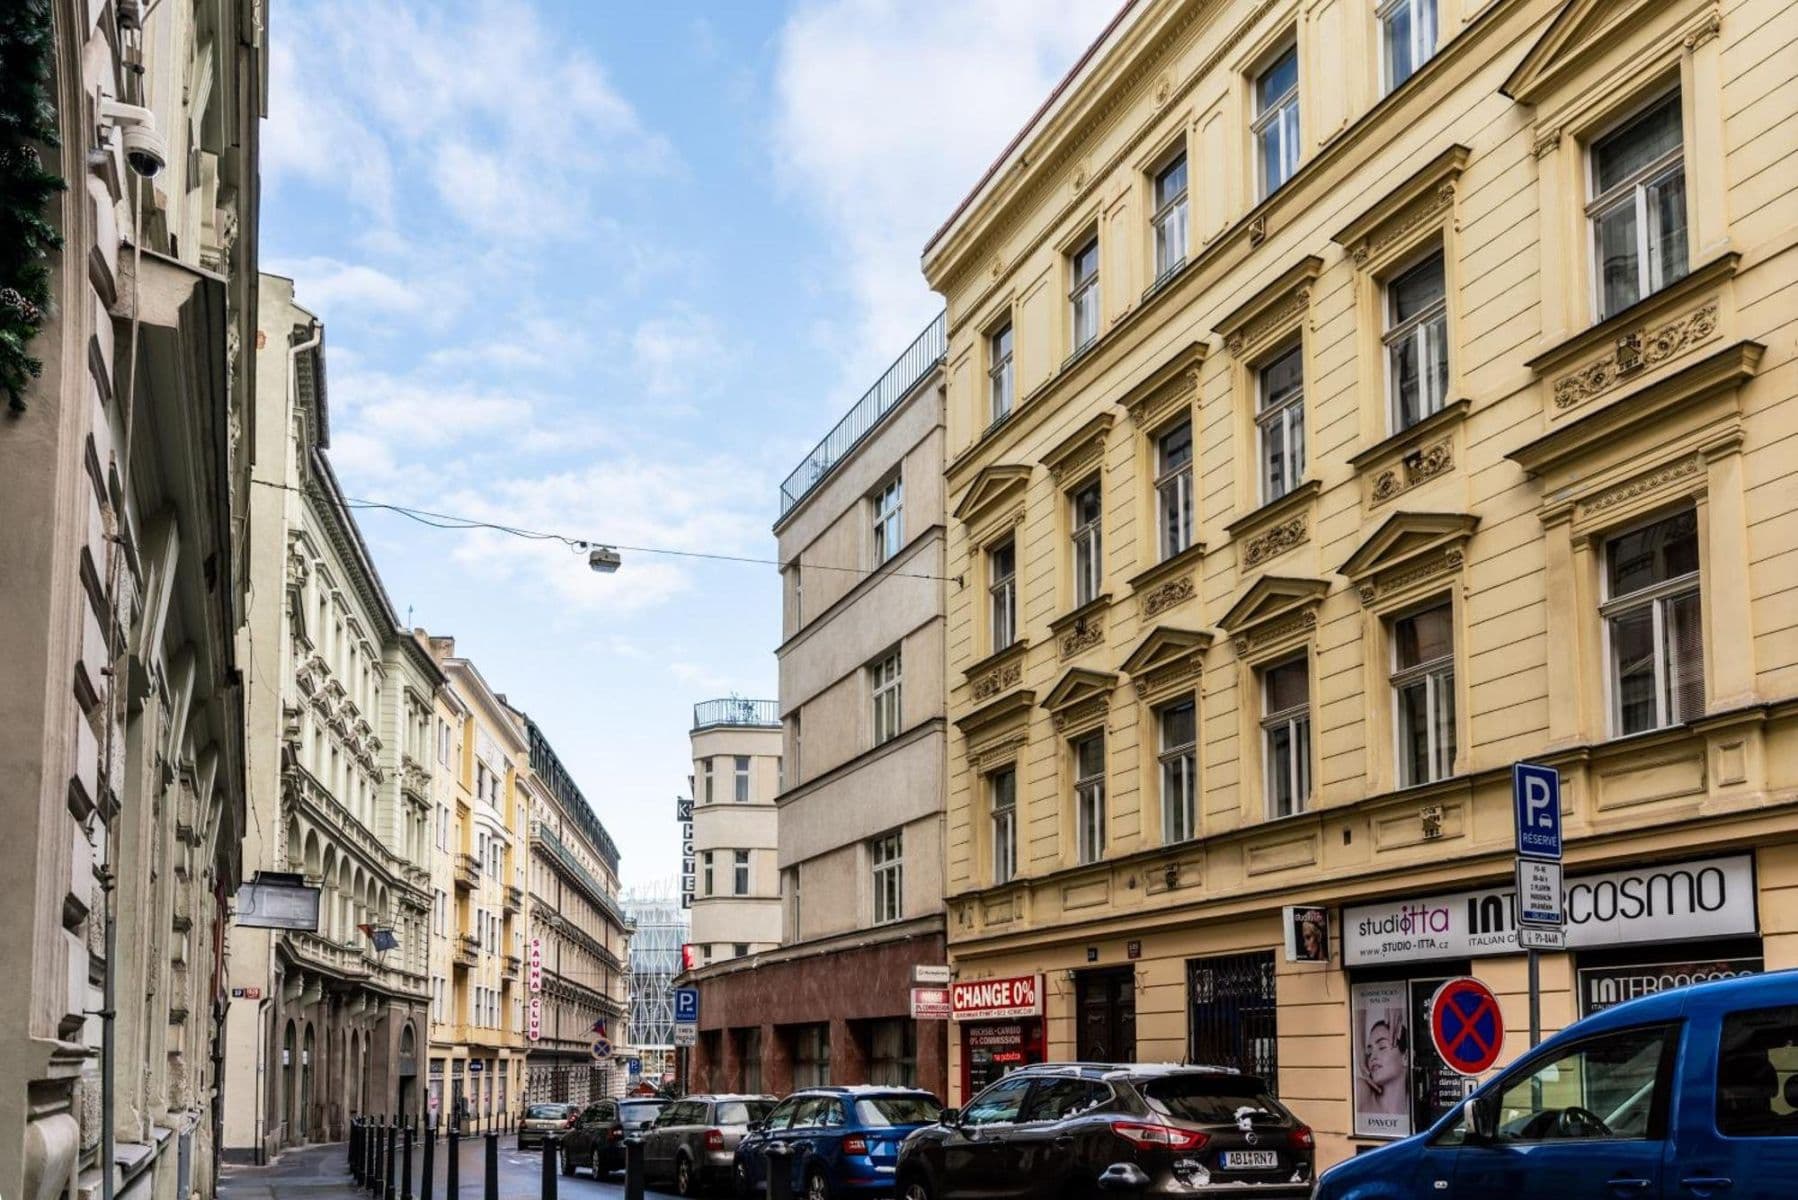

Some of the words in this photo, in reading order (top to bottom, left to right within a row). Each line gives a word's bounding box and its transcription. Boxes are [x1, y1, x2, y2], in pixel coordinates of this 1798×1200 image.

[1525, 775, 1551, 827] P
[1469, 935, 1505, 946] ITALIAN
[531, 940, 540, 989] SAUNA
[680, 993, 694, 1011] P
[954, 982, 1011, 1009] CHANGE
[1013, 979, 1034, 1005] 0%
[531, 1001, 539, 1038] CLUB
